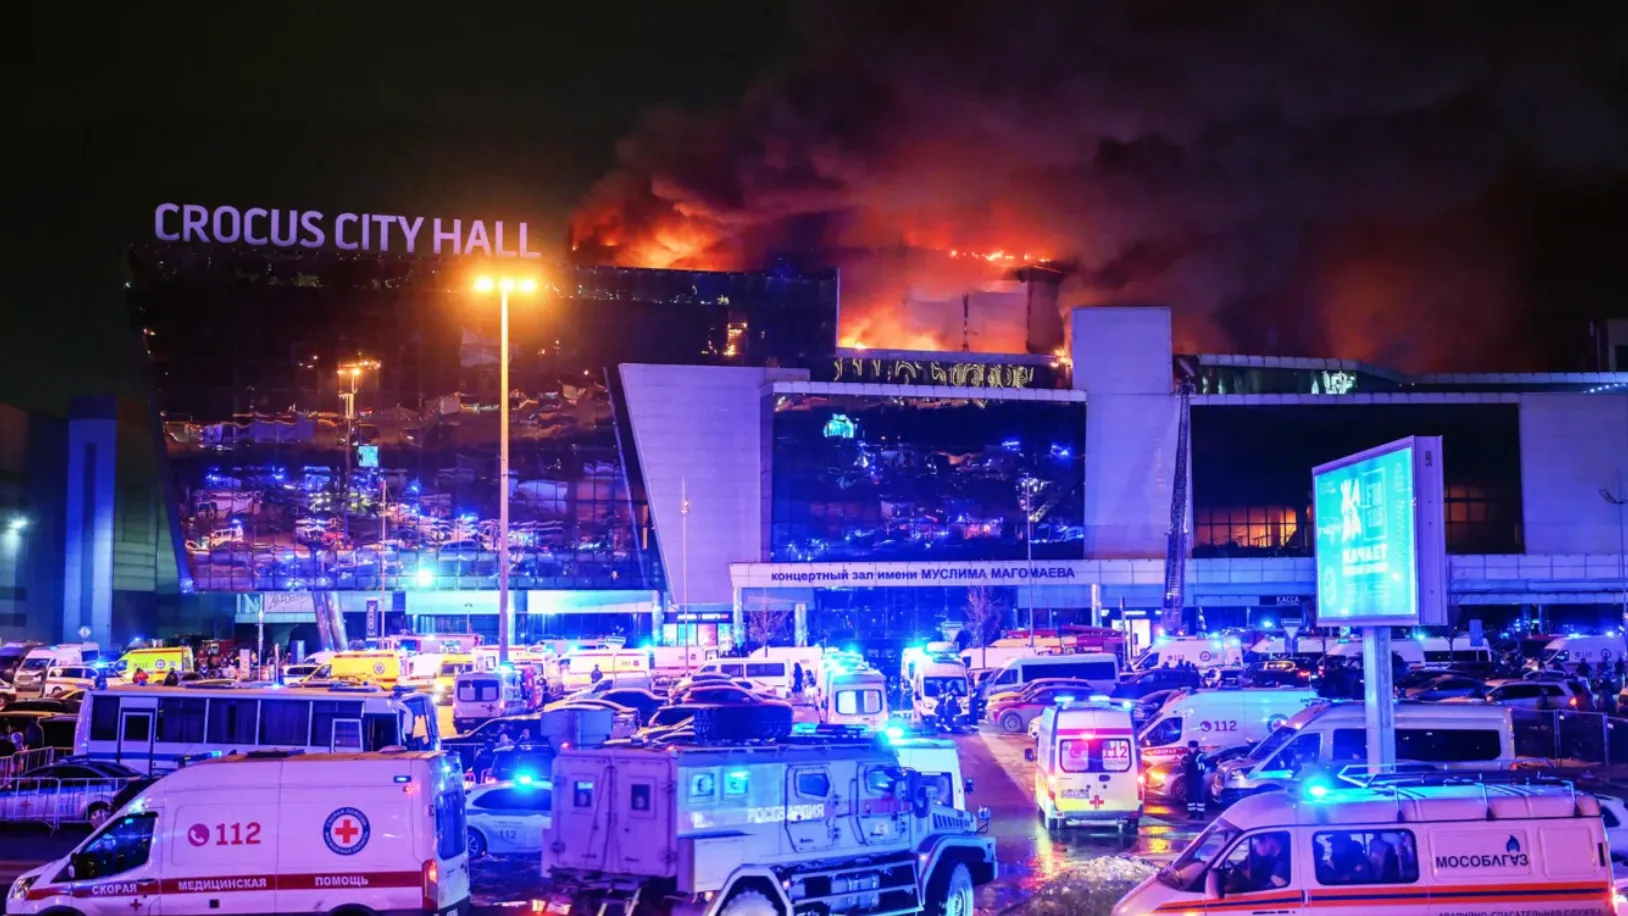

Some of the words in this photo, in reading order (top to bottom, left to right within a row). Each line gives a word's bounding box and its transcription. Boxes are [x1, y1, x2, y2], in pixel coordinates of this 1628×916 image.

[155, 202, 326, 248] CROCUS
[335, 212, 425, 253] CITY
[433, 217, 542, 258] HALL
[771, 569, 849, 583] концертный
[852, 571, 874, 580] зал
[877, 570, 917, 580] имени
[921, 568, 987, 579] МУСЛИМА
[991, 567, 1076, 578] МАГОМАЕВА
[1276, 595, 1300, 603] КАССА
[1214, 719, 1238, 732] 112
[1103, 746, 1128, 758] 112
[215, 821, 261, 846] 112
[500, 829, 517, 840] 112
[1435, 853, 1529, 869] МОСОБЛГАЗ
[91, 884, 138, 895] СКОРАЯ
[178, 878, 267, 892] МЕДИЦИНСКАЯ
[314, 875, 369, 887] ПОМОЩЬ
